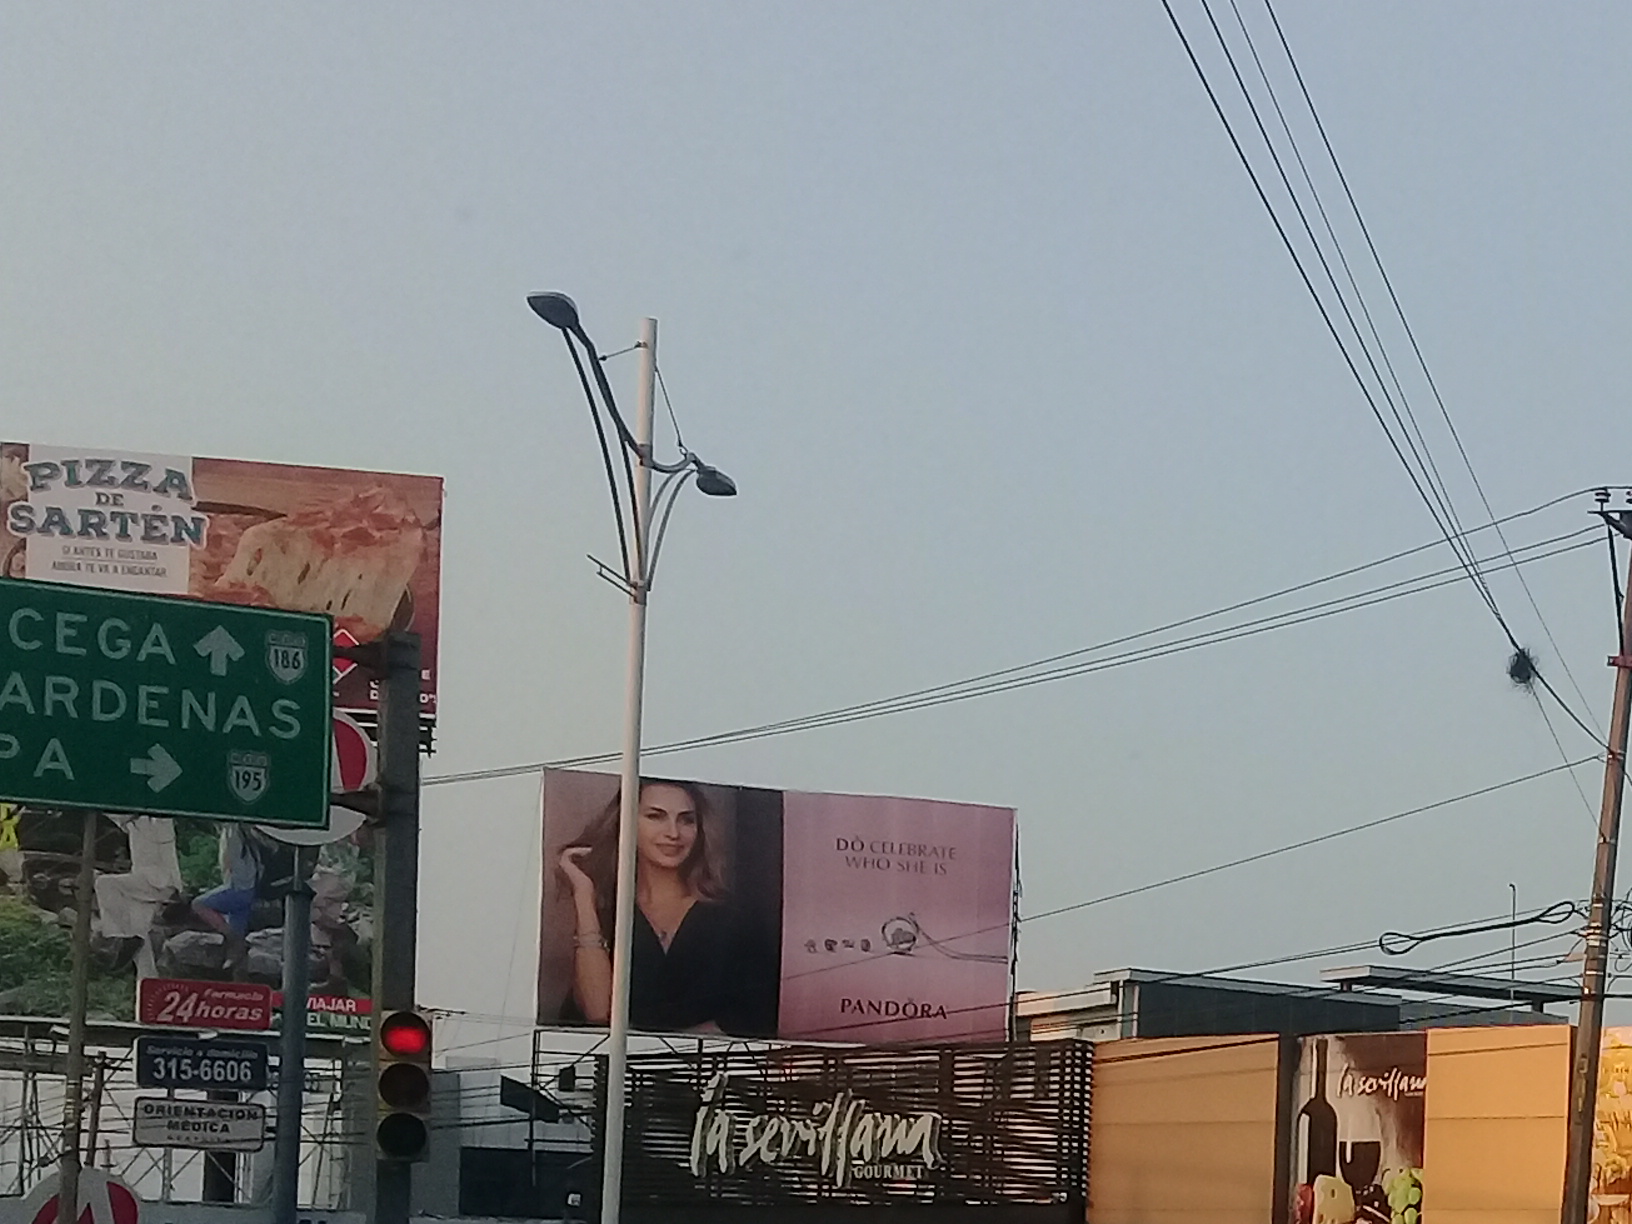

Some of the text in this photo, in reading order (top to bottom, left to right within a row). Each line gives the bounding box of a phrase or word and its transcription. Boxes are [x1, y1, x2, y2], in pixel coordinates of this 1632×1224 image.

[23, 459, 193, 500] PIZZA
[96, 492, 124, 506] DE
[10, 504, 206, 546] SARTÉN
[274, 649, 301, 670] 186
[235, 770, 262, 791] 195
[870, 841, 957, 860] CELEBRATE
[845, 856, 947, 875] WHO SHE IS
[156, 991, 199, 1022] 24
[195, 1001, 264, 1020] horas
[153, 1057, 252, 1081] 315-6606
[852, 1165, 924, 1180] GOURMET
